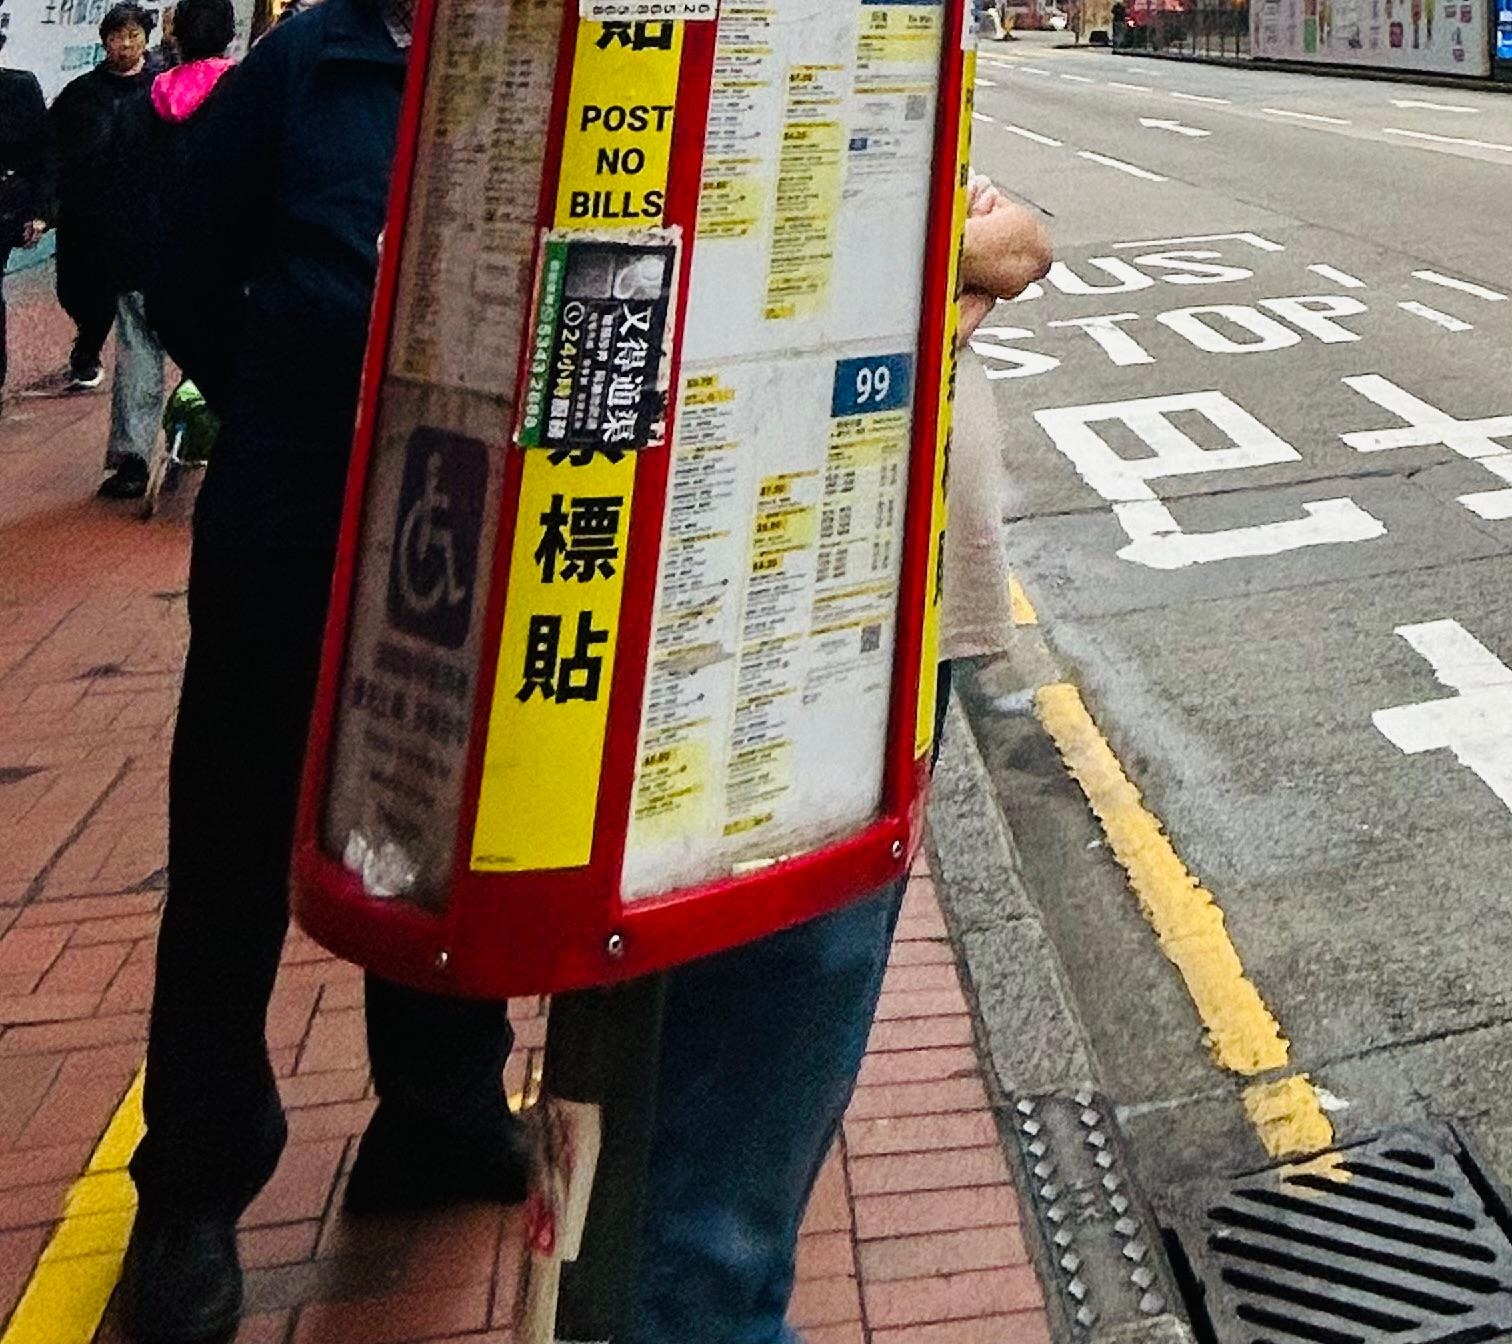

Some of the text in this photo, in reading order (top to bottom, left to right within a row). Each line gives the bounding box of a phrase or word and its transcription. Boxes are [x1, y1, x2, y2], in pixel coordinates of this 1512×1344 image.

[580, 106, 673, 133] POST
[595, 148, 645, 175] NO
[569, 191, 664, 219] BILLS
[968, 295, 1369, 380] STOP
[856, 365, 891, 404] 99
[516, 494, 624, 705] 標貼
